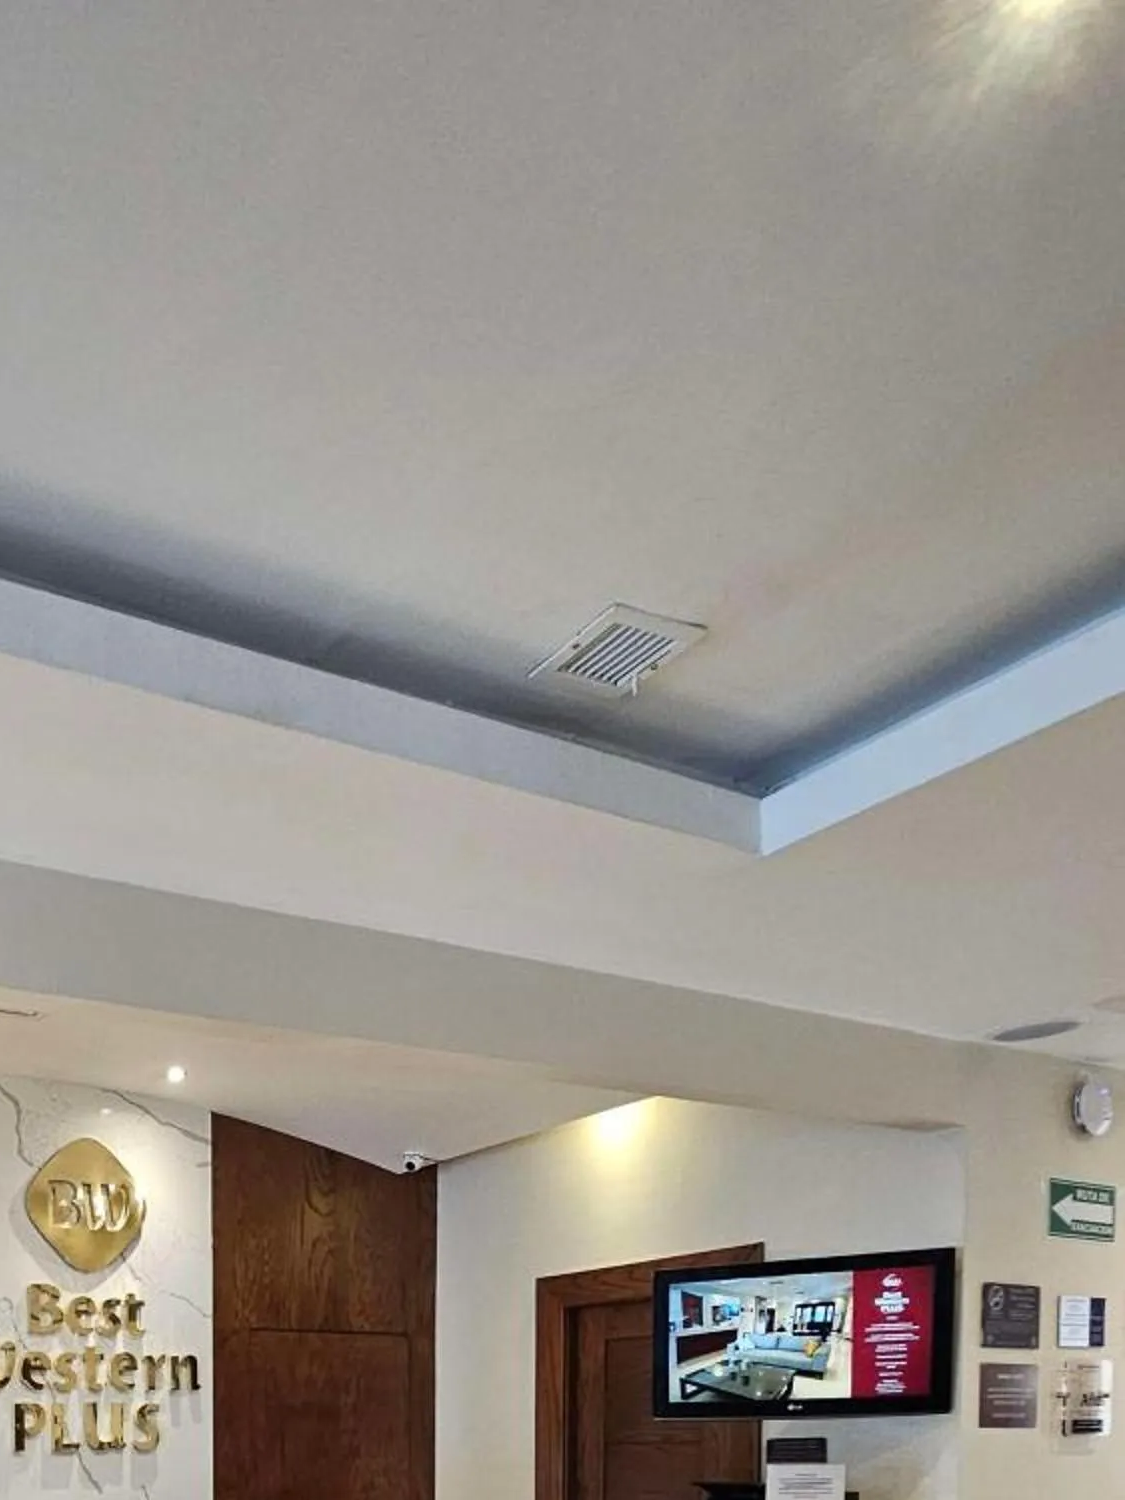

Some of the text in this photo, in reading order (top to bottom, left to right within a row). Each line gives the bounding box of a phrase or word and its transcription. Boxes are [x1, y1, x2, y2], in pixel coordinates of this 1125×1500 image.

[48, 1179, 130, 1232] BW
[27, 1283, 146, 1337] Best
[14, 1403, 161, 1455] PLUS
